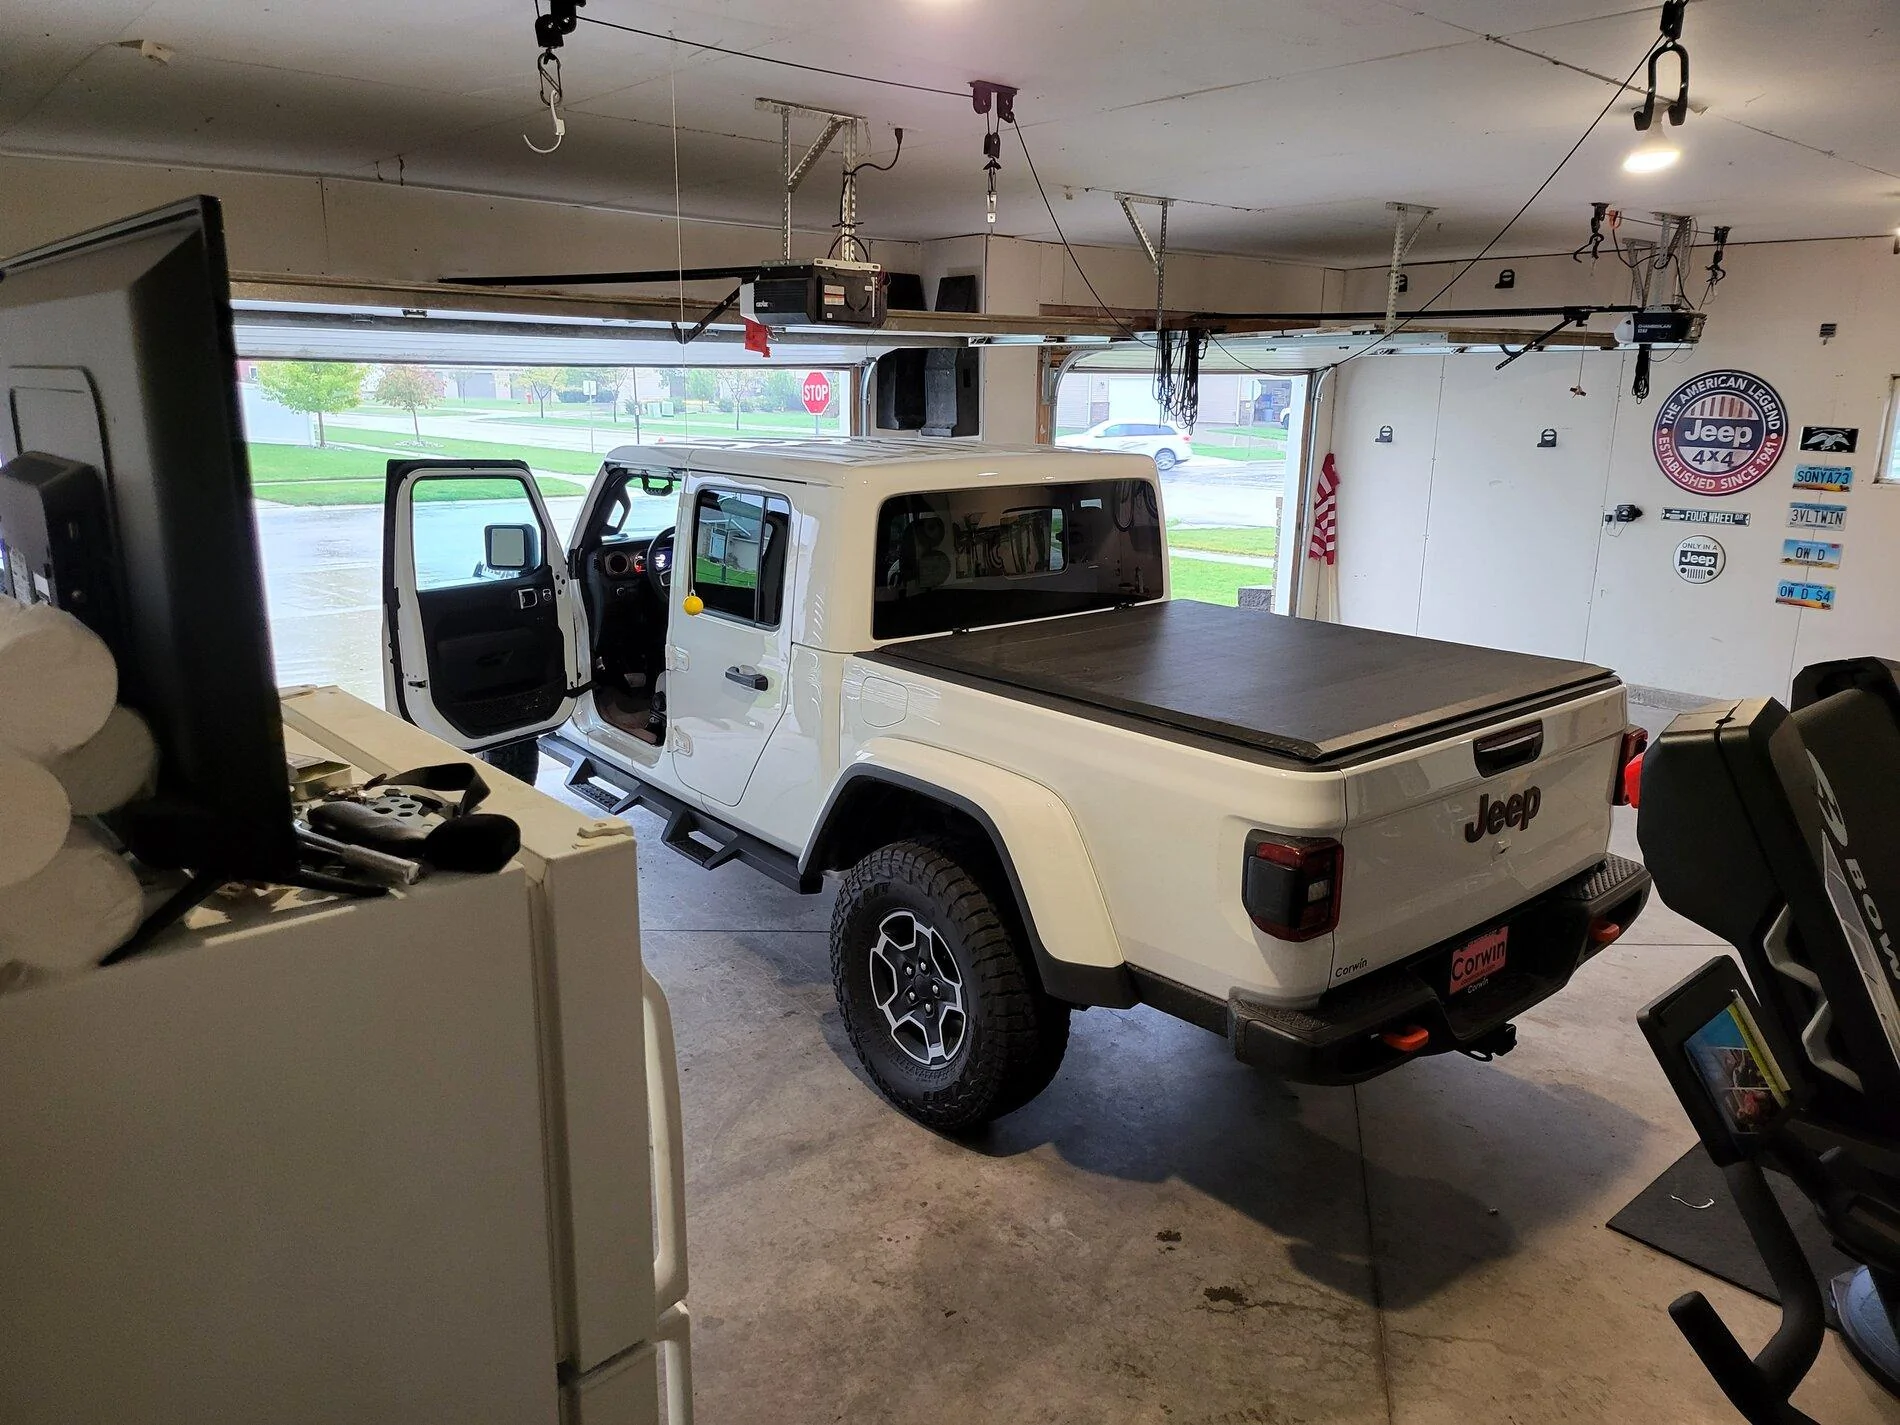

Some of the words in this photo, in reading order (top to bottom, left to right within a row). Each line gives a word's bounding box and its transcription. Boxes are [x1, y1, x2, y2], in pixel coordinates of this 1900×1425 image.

[803, 384, 828, 402] STOP
[1662, 402, 1681, 425] THE
[1679, 376, 1748, 404] AMERICAN
[1747, 384, 1781, 430] LEGEND
[1684, 419, 1753, 448] Jeep
[1658, 436, 1716, 489] ESTABLISHED
[1720, 465, 1760, 489] SINCE
[1756, 440, 1778, 466] 1941
[1797, 470, 1850, 485] SONYA73
[1685, 510, 1708, 522] FOUR
[1708, 512, 1735, 524] WHEEL
[1791, 509, 1844, 525] 3VLTWIN
[1681, 551, 1715, 567] Jeep
[1464, 786, 1541, 843] Jeep
[1335, 957, 1368, 979] Corwin
[1451, 941, 1506, 981] Corwin
[1467, 977, 1489, 994] Corwin
